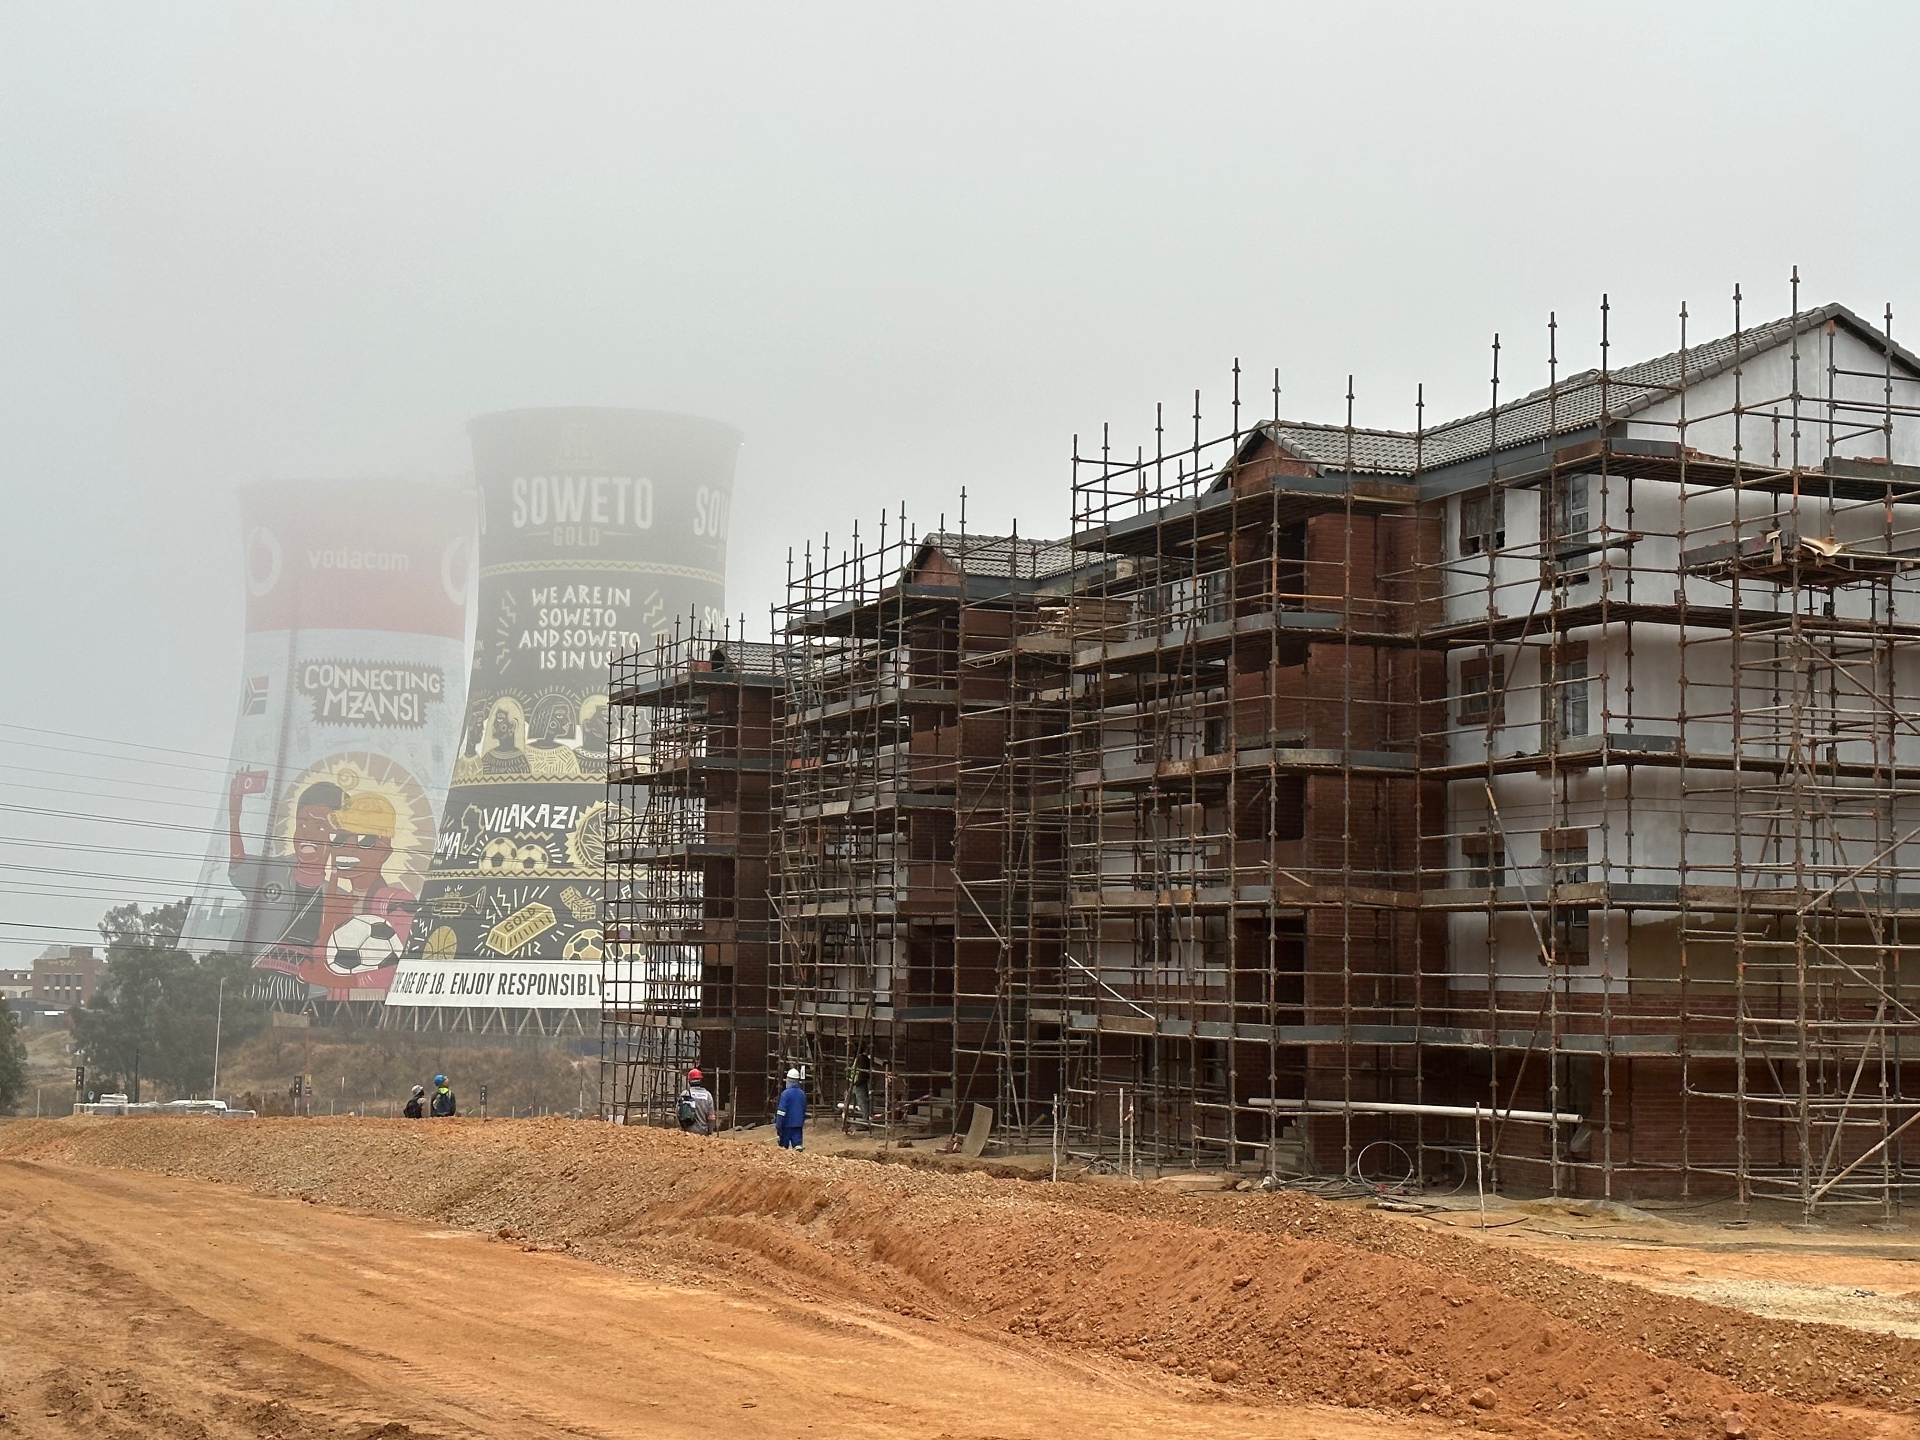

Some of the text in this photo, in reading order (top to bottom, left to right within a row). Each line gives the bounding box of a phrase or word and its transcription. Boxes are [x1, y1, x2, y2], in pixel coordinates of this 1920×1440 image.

[511, 476, 654, 530] SOWETO
[553, 526, 600, 547] GOLD
[305, 547, 410, 572] vodacom
[531, 584, 631, 607] WE ARE IN
[538, 607, 617, 628] SOWETO
[518, 629, 641, 650] AND SOWETO
[539, 650, 615, 670] IS IN US
[304, 664, 442, 694] CONNECTING
[322, 687, 419, 722] MZANSI
[483, 803, 578, 834] VILAKAZI
[504, 907, 536, 932] GOLD
[400, 972, 418, 994] AGE
[415, 972, 430, 995] OF
[429, 972, 445, 995] 18.
[450, 972, 496, 995] ENJOY
[497, 972, 610, 997] RESPONSIBLY.
